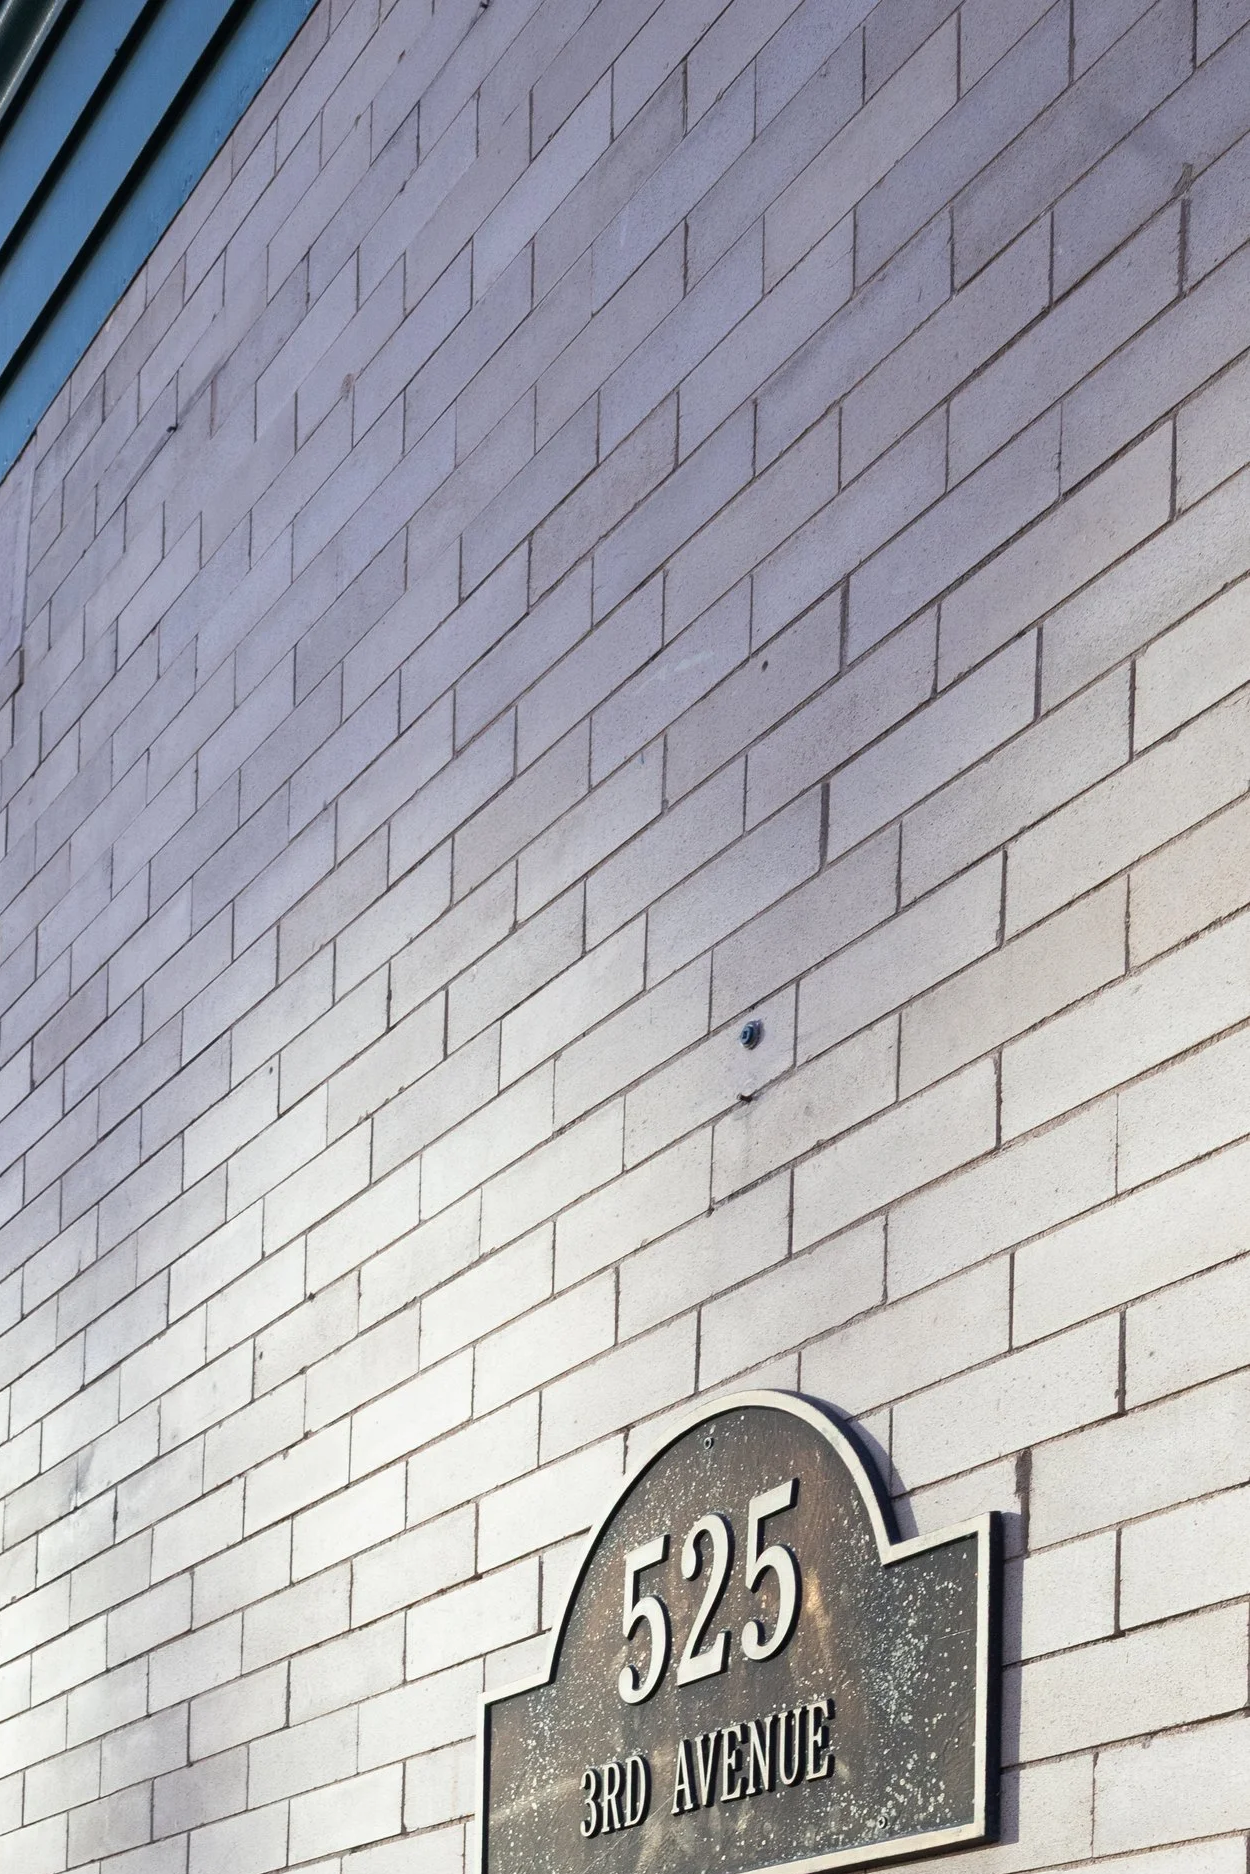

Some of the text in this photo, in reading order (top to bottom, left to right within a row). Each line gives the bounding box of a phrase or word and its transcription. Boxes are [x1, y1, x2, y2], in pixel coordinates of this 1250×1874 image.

[618, 1478, 801, 1704] 525
[579, 1699, 835, 1838] 3RD AVENUE
